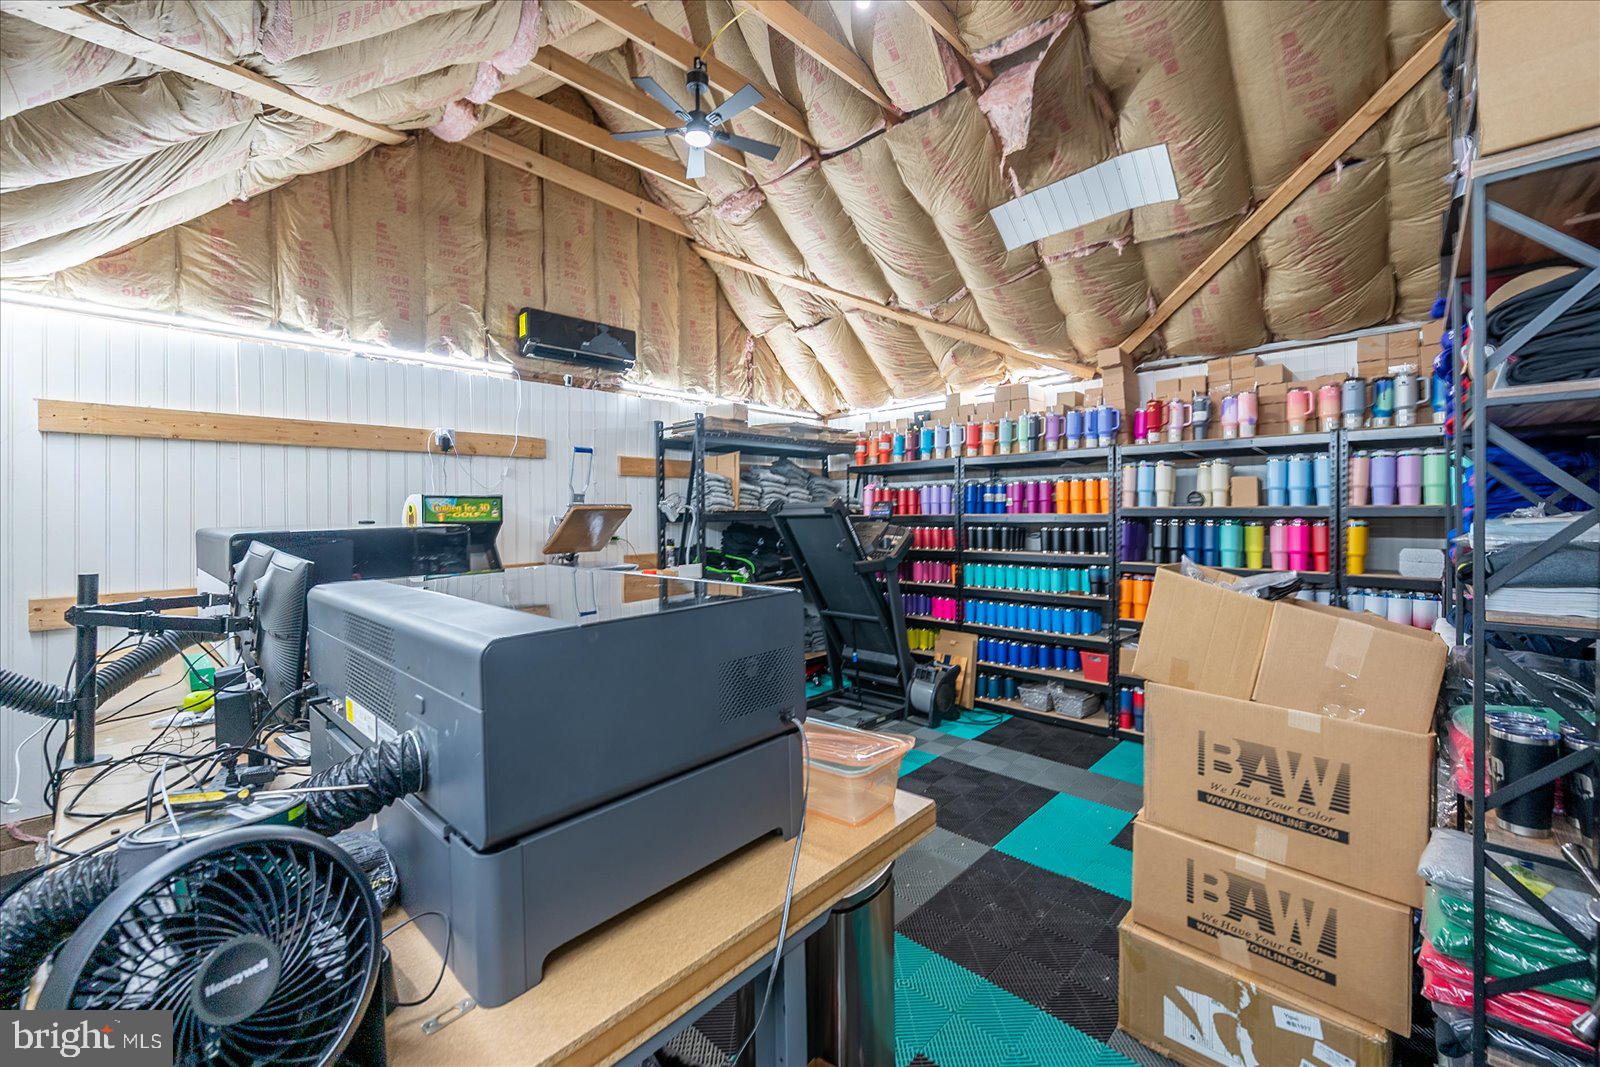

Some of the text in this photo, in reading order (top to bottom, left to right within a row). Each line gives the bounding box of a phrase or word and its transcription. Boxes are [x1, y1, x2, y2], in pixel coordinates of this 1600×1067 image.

[299, 277, 319, 289] R19
[377, 258, 395, 269] R19
[465, 503, 477, 512] Tee
[1198, 730, 1350, 815] BAW
[1205, 794, 1340, 840] WWW.BAWONLINE.COM
[1210, 782, 1337, 824] We Have Your Color
[1187, 858, 1337, 959] BAW
[1201, 912, 1324, 966] We Have Your Color
[205, 958, 269, 998] Honeywell
